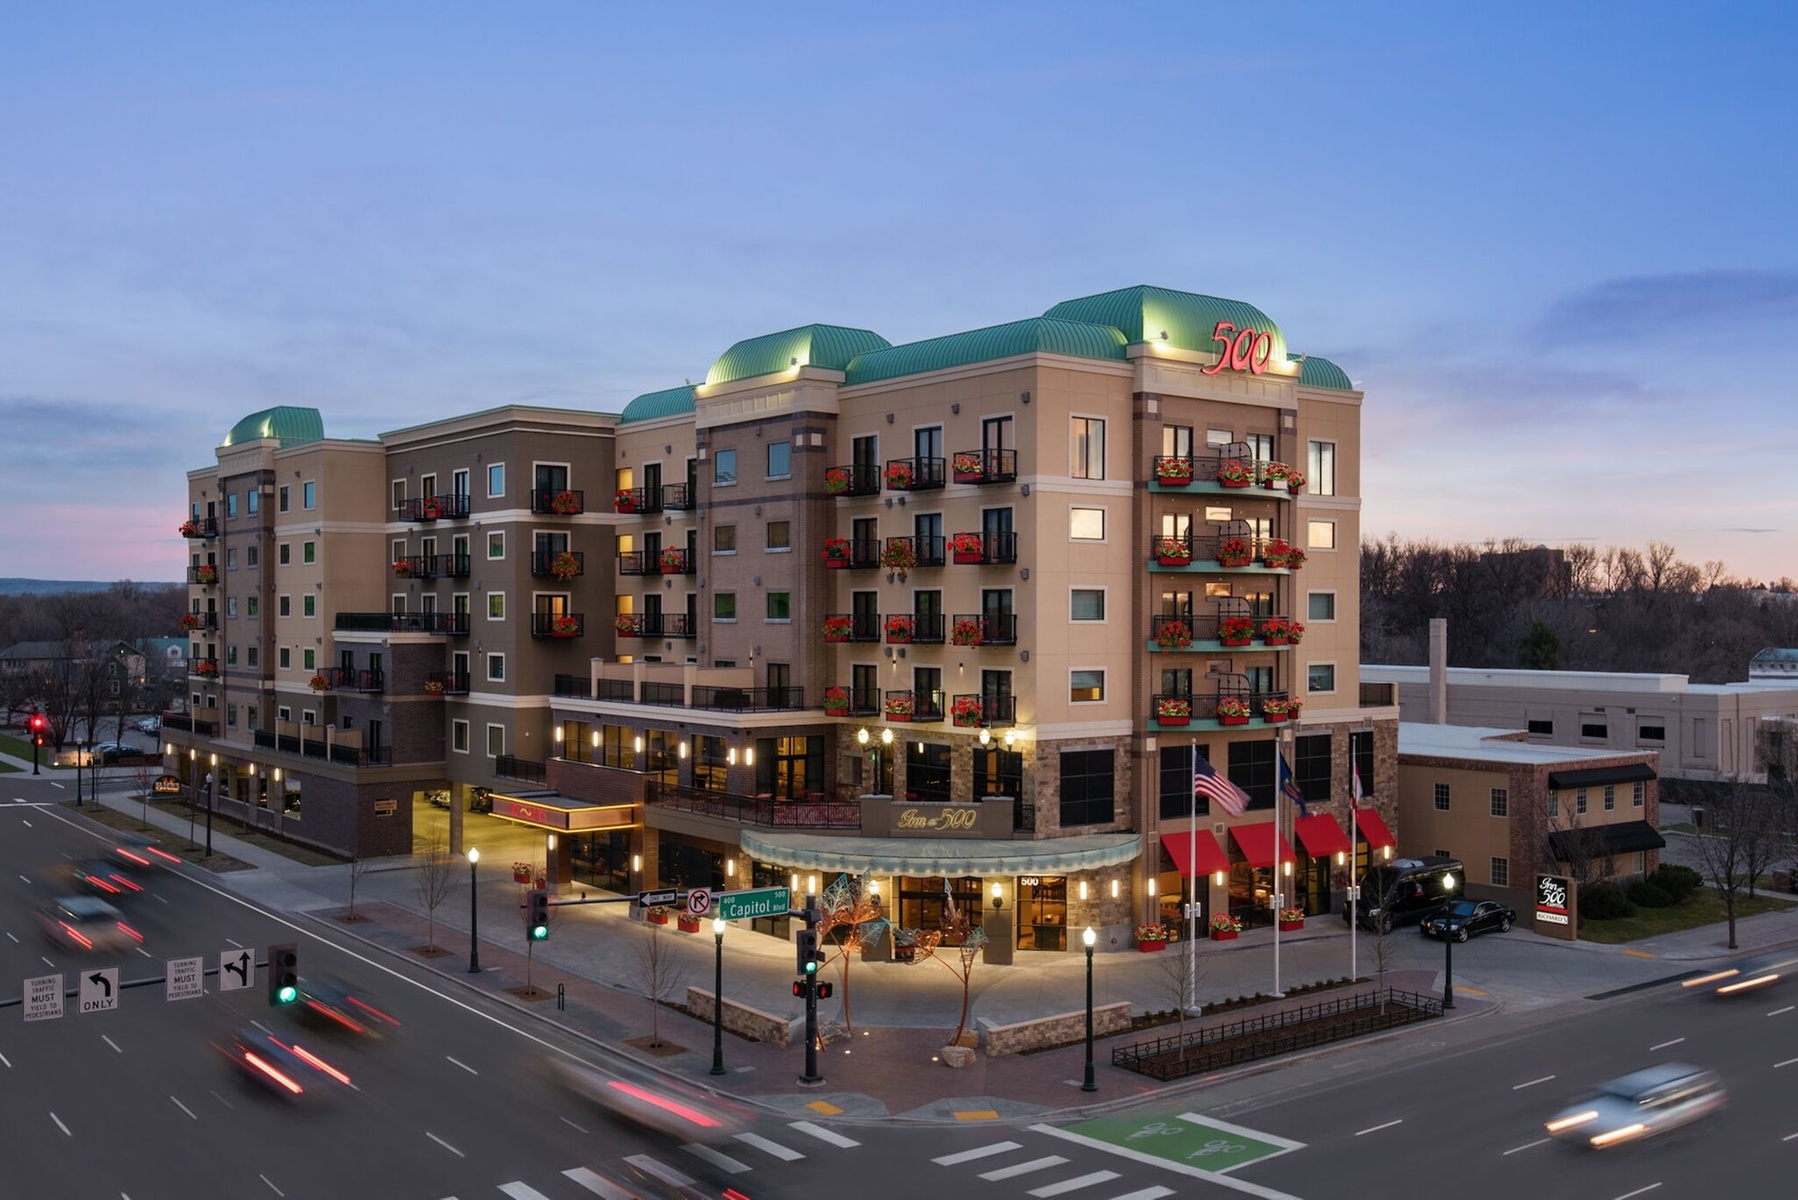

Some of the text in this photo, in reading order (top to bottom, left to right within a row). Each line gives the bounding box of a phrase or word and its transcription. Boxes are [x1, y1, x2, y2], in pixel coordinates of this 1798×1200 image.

[1200, 321, 1273, 376] 500
[897, 808, 926, 828] Inn
[935, 808, 977, 831] 500
[1021, 877, 1039, 886] 500
[1539, 877, 1558, 890] Inn
[724, 896, 735, 904] 400
[1539, 889, 1566, 904] 500
[723, 899, 785, 918] S Capitol Blvd
[174, 960, 197, 968] TURNING
[31, 978, 56, 986] TURNING
[174, 974, 195, 984] MUST
[32, 985, 55, 994] TRAFFIC
[168, 989, 201, 999] PEDESTRIANS
[31, 993, 55, 1003] MUST
[30, 1003, 47, 1011] YIELD
[84, 999, 114, 1011] ONLY
[25, 1009, 62, 1019] PEDESTRIANS
